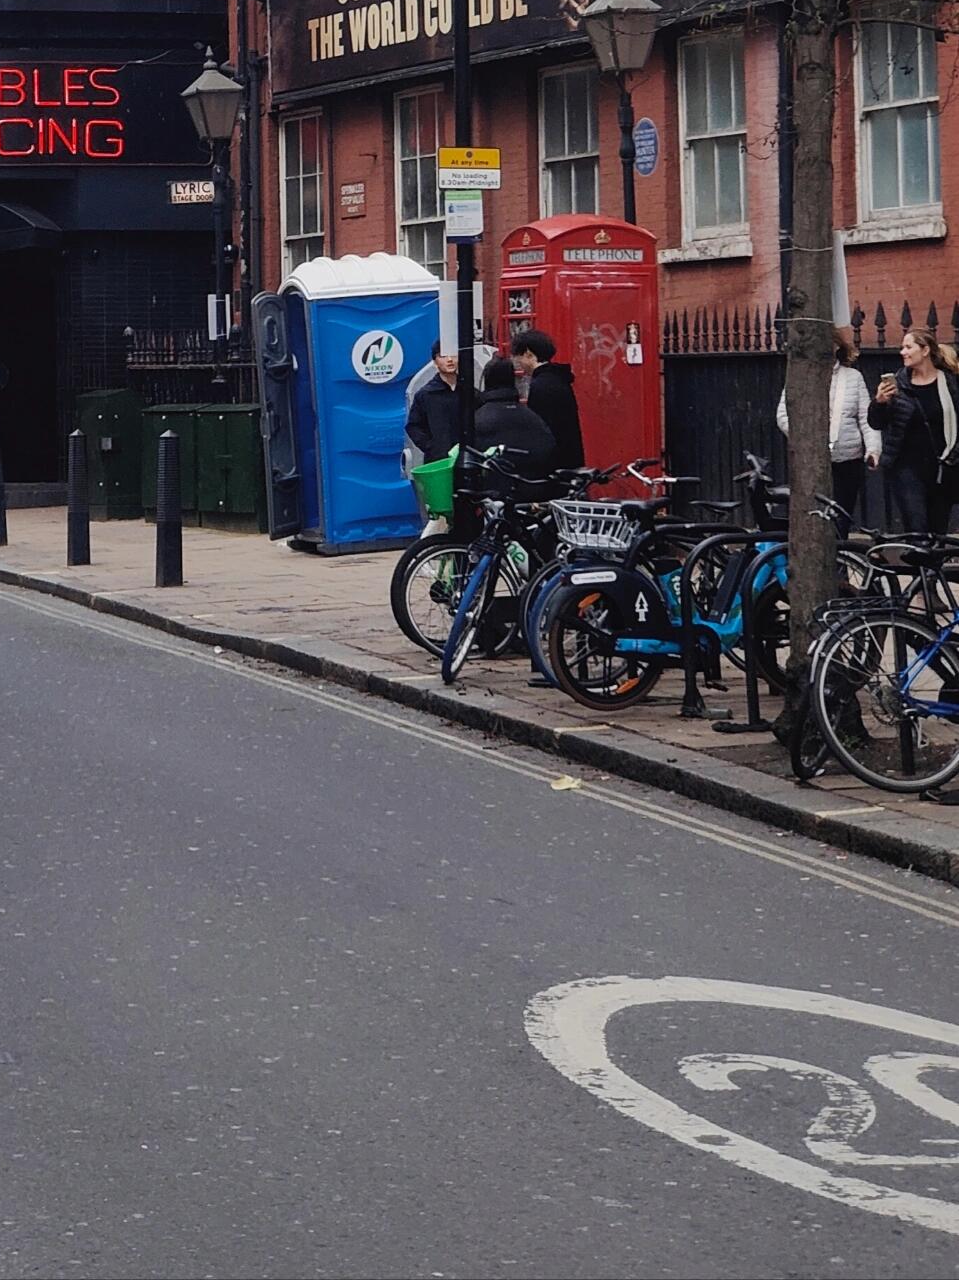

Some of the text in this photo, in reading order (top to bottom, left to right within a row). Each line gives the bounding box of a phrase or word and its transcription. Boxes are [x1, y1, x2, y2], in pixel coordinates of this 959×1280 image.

[307, 12, 345, 62] THE
[174, 182, 211, 194] LYRIC
[568, 249, 639, 261] TELEPHONE
